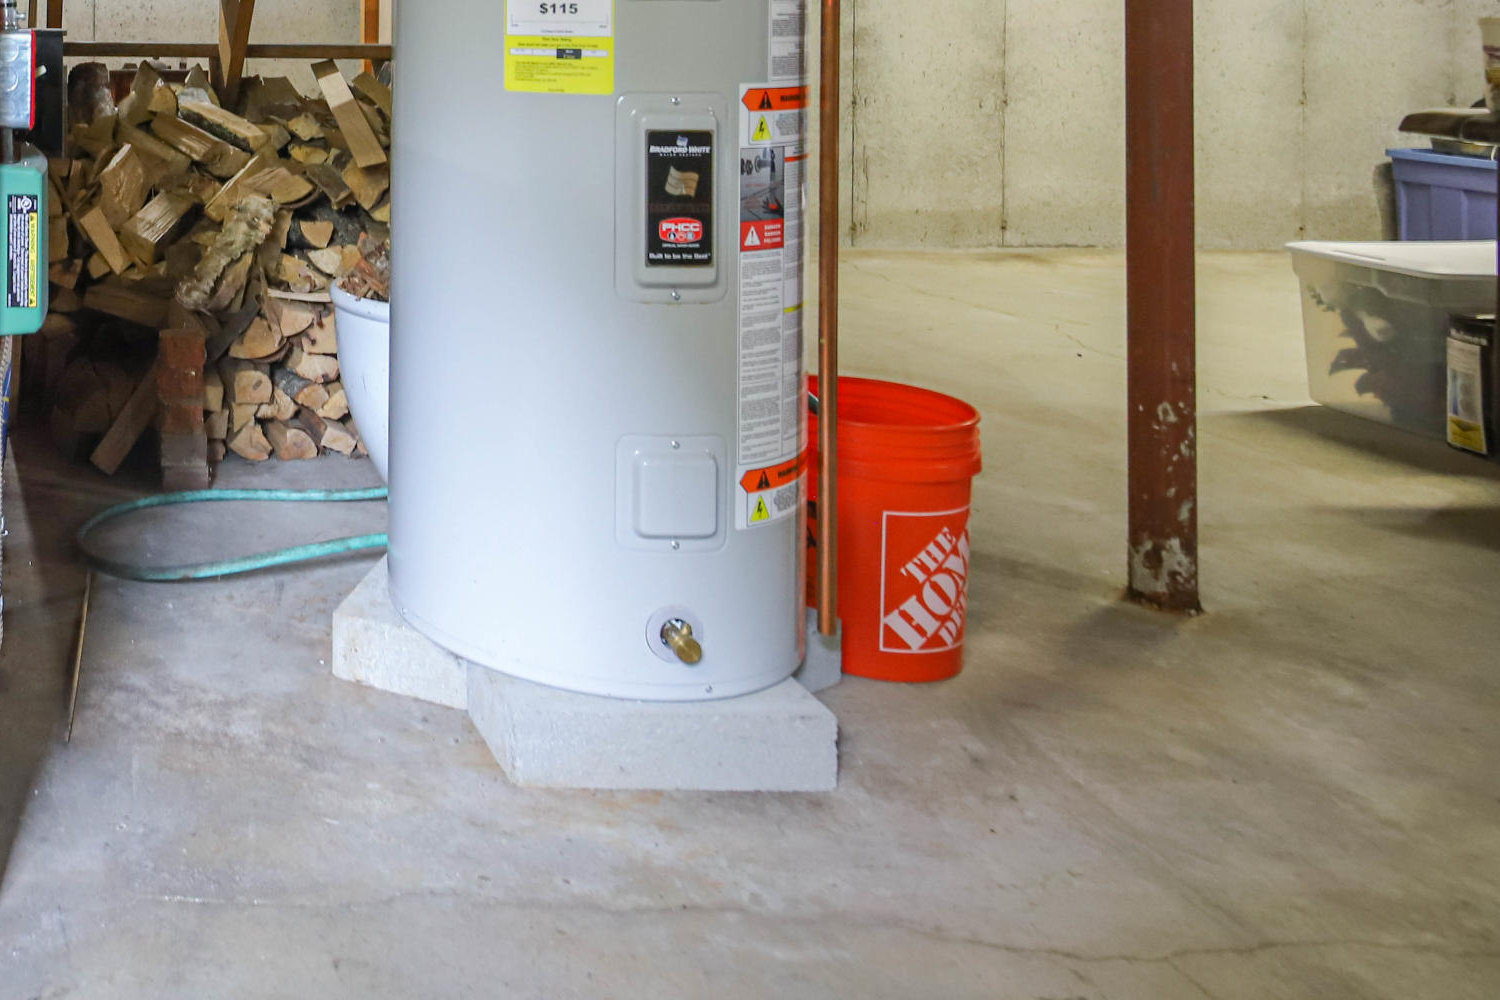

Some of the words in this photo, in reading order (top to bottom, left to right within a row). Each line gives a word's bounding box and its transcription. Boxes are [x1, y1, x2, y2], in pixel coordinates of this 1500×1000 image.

[540, 2, 578, 15] $115
[900, 526, 956, 584] THE
[884, 529, 969, 650] HOM
